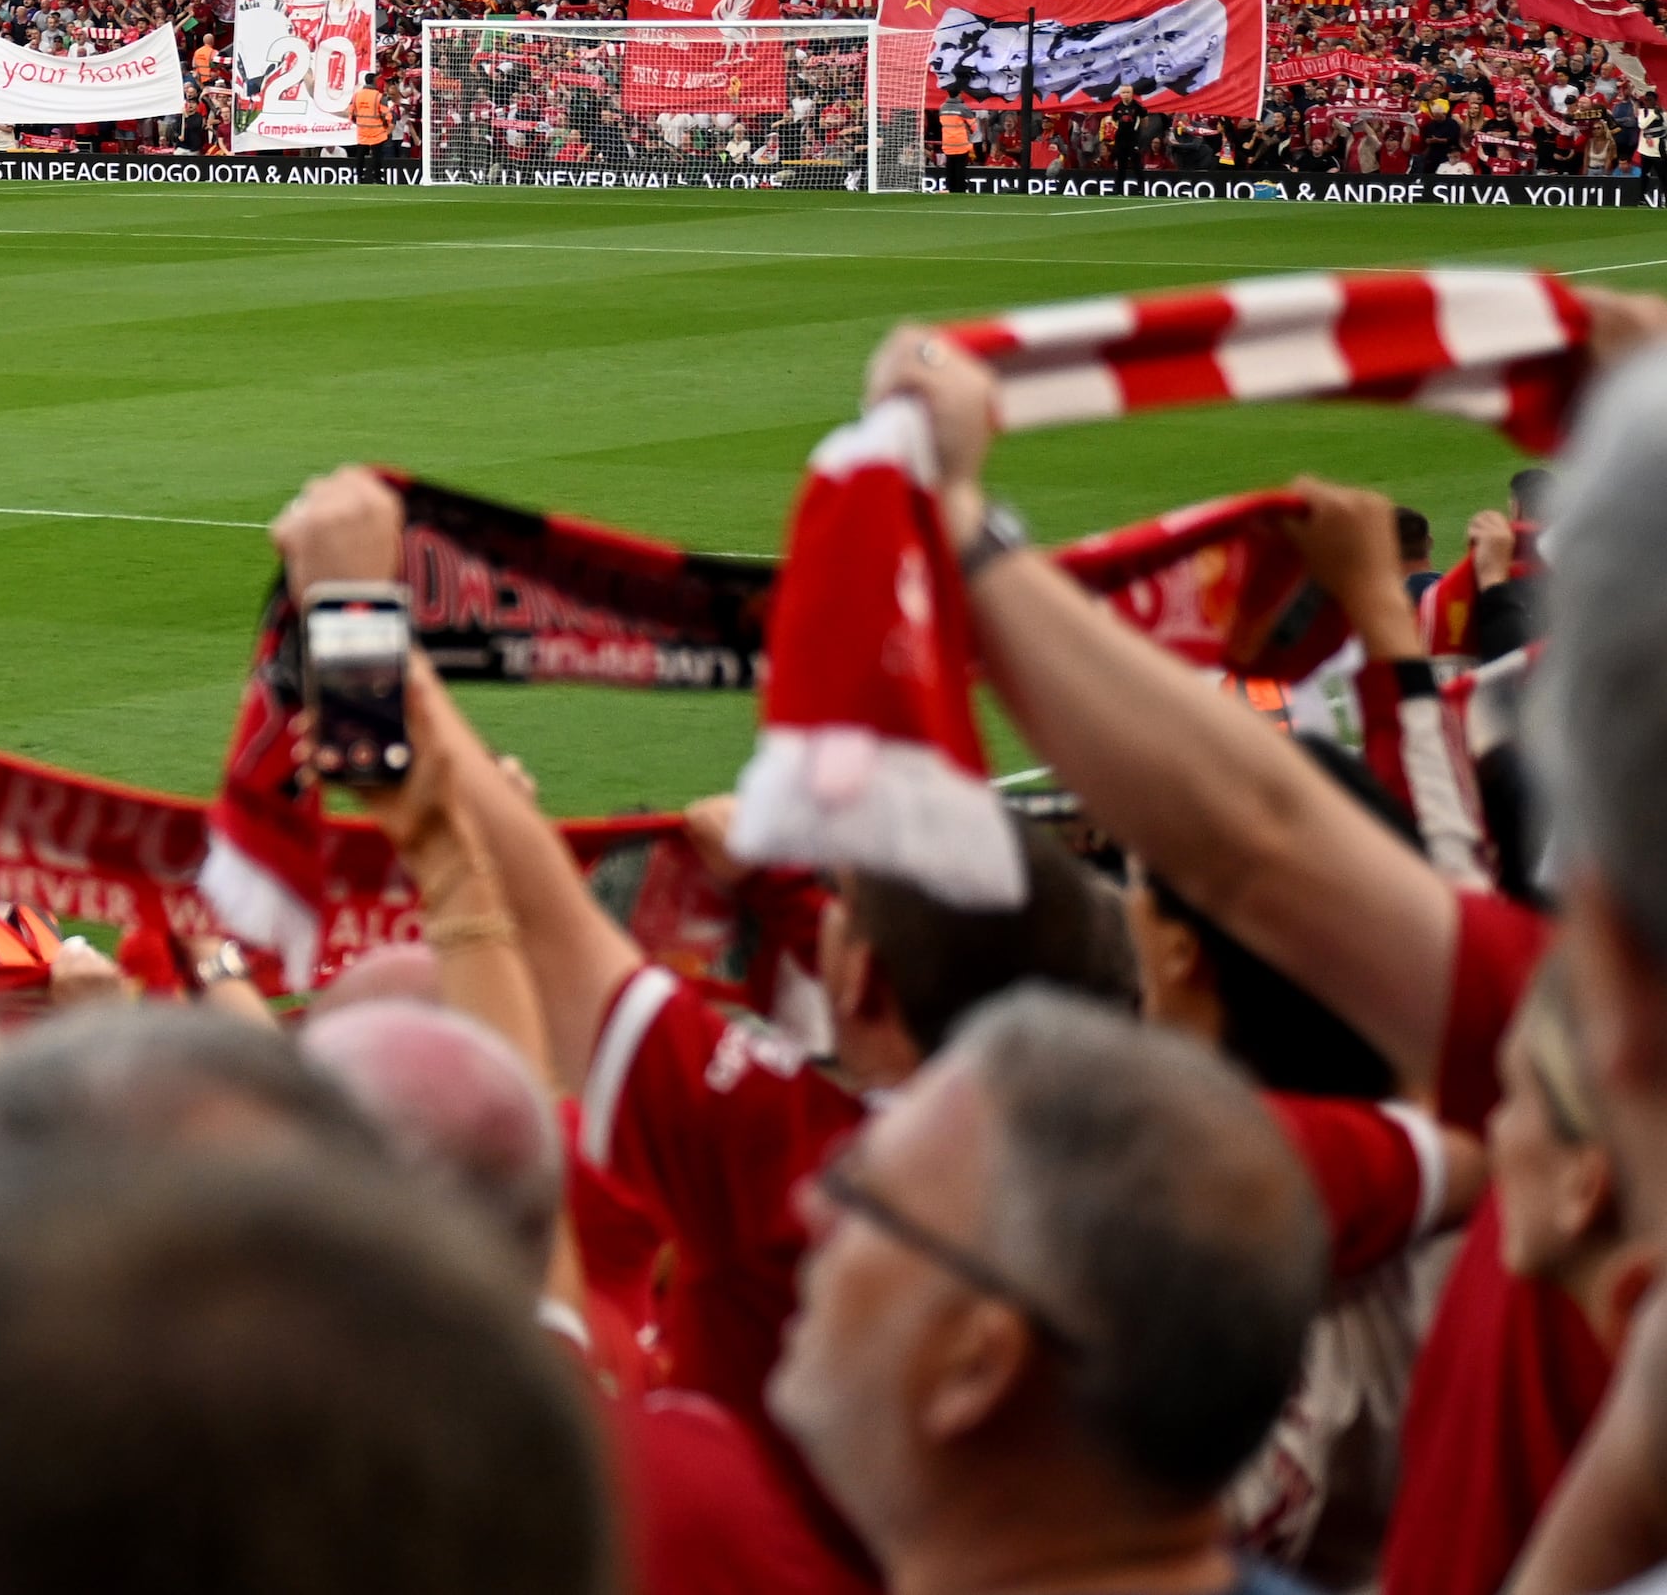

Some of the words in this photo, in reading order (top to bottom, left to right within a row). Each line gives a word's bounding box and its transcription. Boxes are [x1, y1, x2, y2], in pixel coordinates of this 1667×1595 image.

[2, 59, 66, 89] your
[77, 54, 158, 84] home
[262, 36, 357, 115] 20
[633, 66, 659, 86] THIS
[665, 70, 679, 88] IS
[21, 161, 43, 181] IN
[48, 161, 120, 182] PEACE
[126, 163, 201, 183] DIOGO
[205, 164, 261, 184] JOTA
[265, 165, 282, 184] &
[1224, 181, 1289, 201] JOA
[1296, 181, 1317, 202] &
[1323, 176, 1423, 203] ANDRÉ
